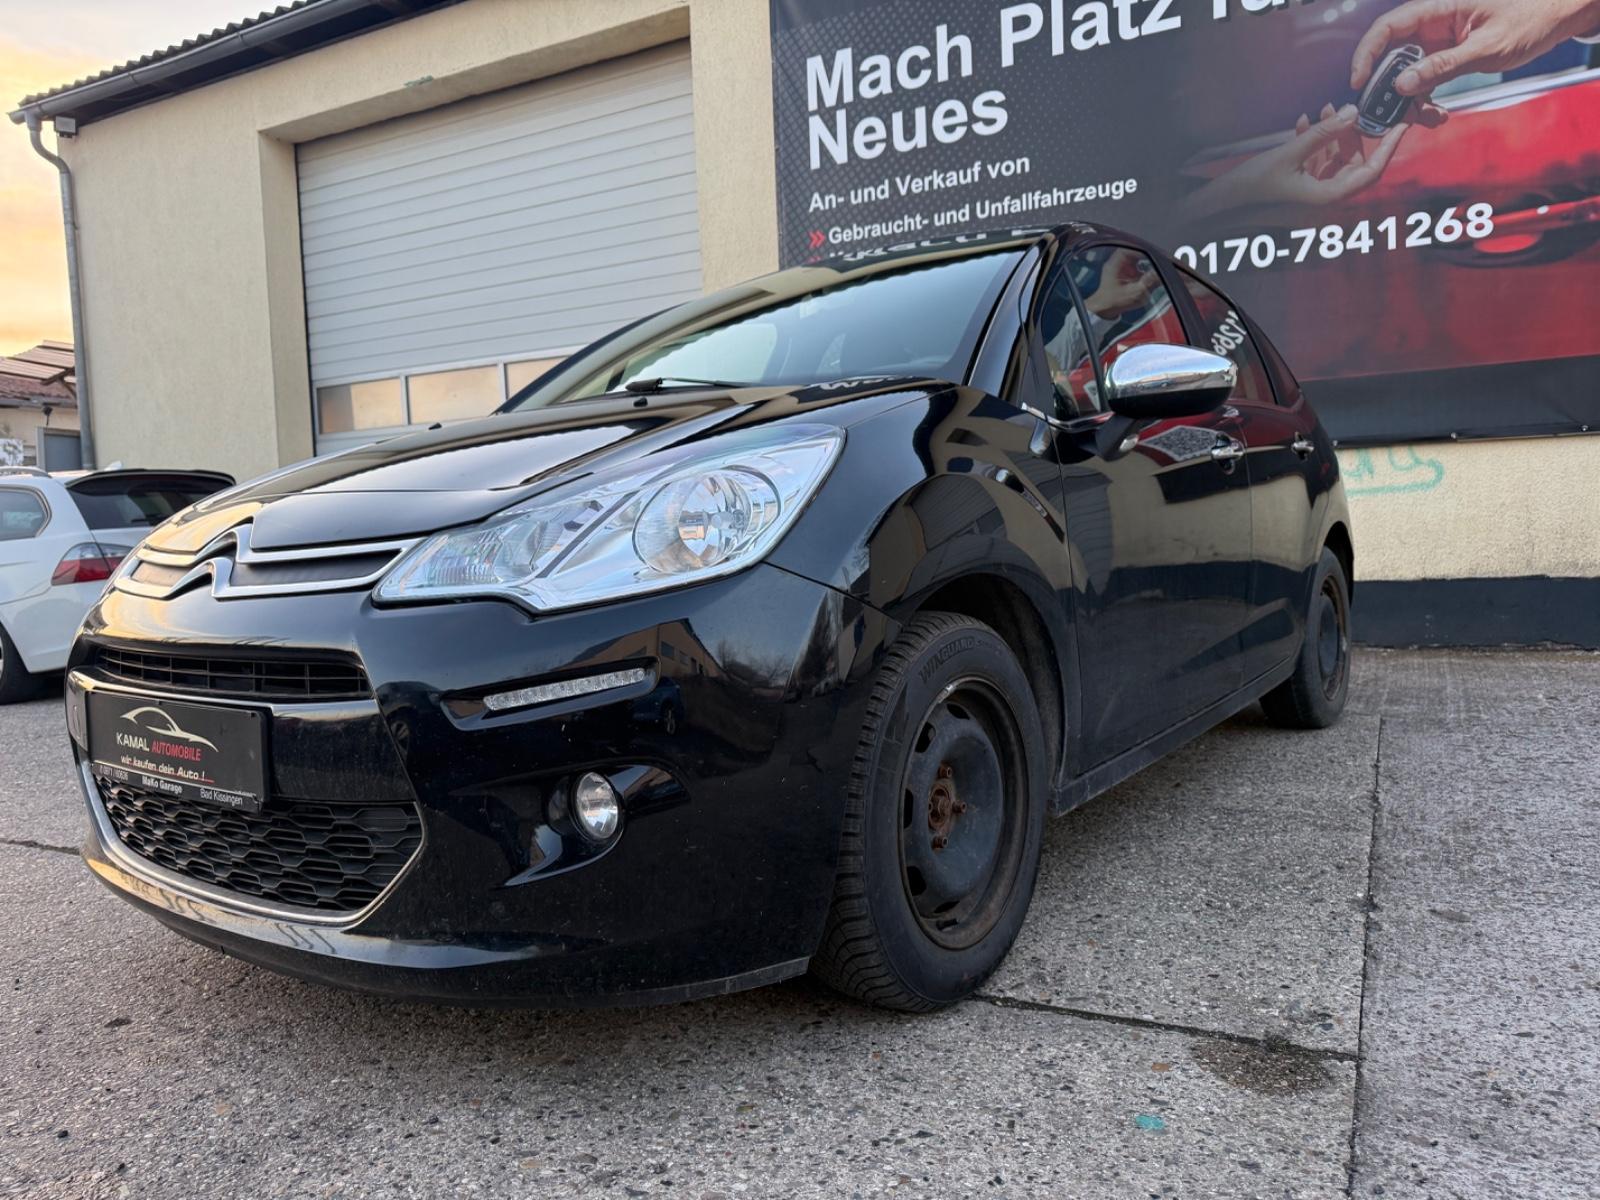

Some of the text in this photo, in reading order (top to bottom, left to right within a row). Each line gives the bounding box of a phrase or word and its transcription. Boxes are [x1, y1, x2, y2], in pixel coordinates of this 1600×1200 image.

[806, 0, 1182, 112] Mach Platz
[808, 90, 1008, 170] Neues
[808, 157, 1030, 213] An- und Verkauf von
[828, 215, 930, 245] Gebraucht-
[934, 203, 970, 227] und
[975, 176, 1138, 219] Unfallfahrzeuge
[116, 732, 201, 762] KAMAL AUTOMOBILE
[133, 757, 157, 771] kaufen
[159, 763, 175, 774] dein
[177, 766, 199, 780] Auto
[160, 780, 183, 795] Garage
[200, 787, 213, 799] Bad
